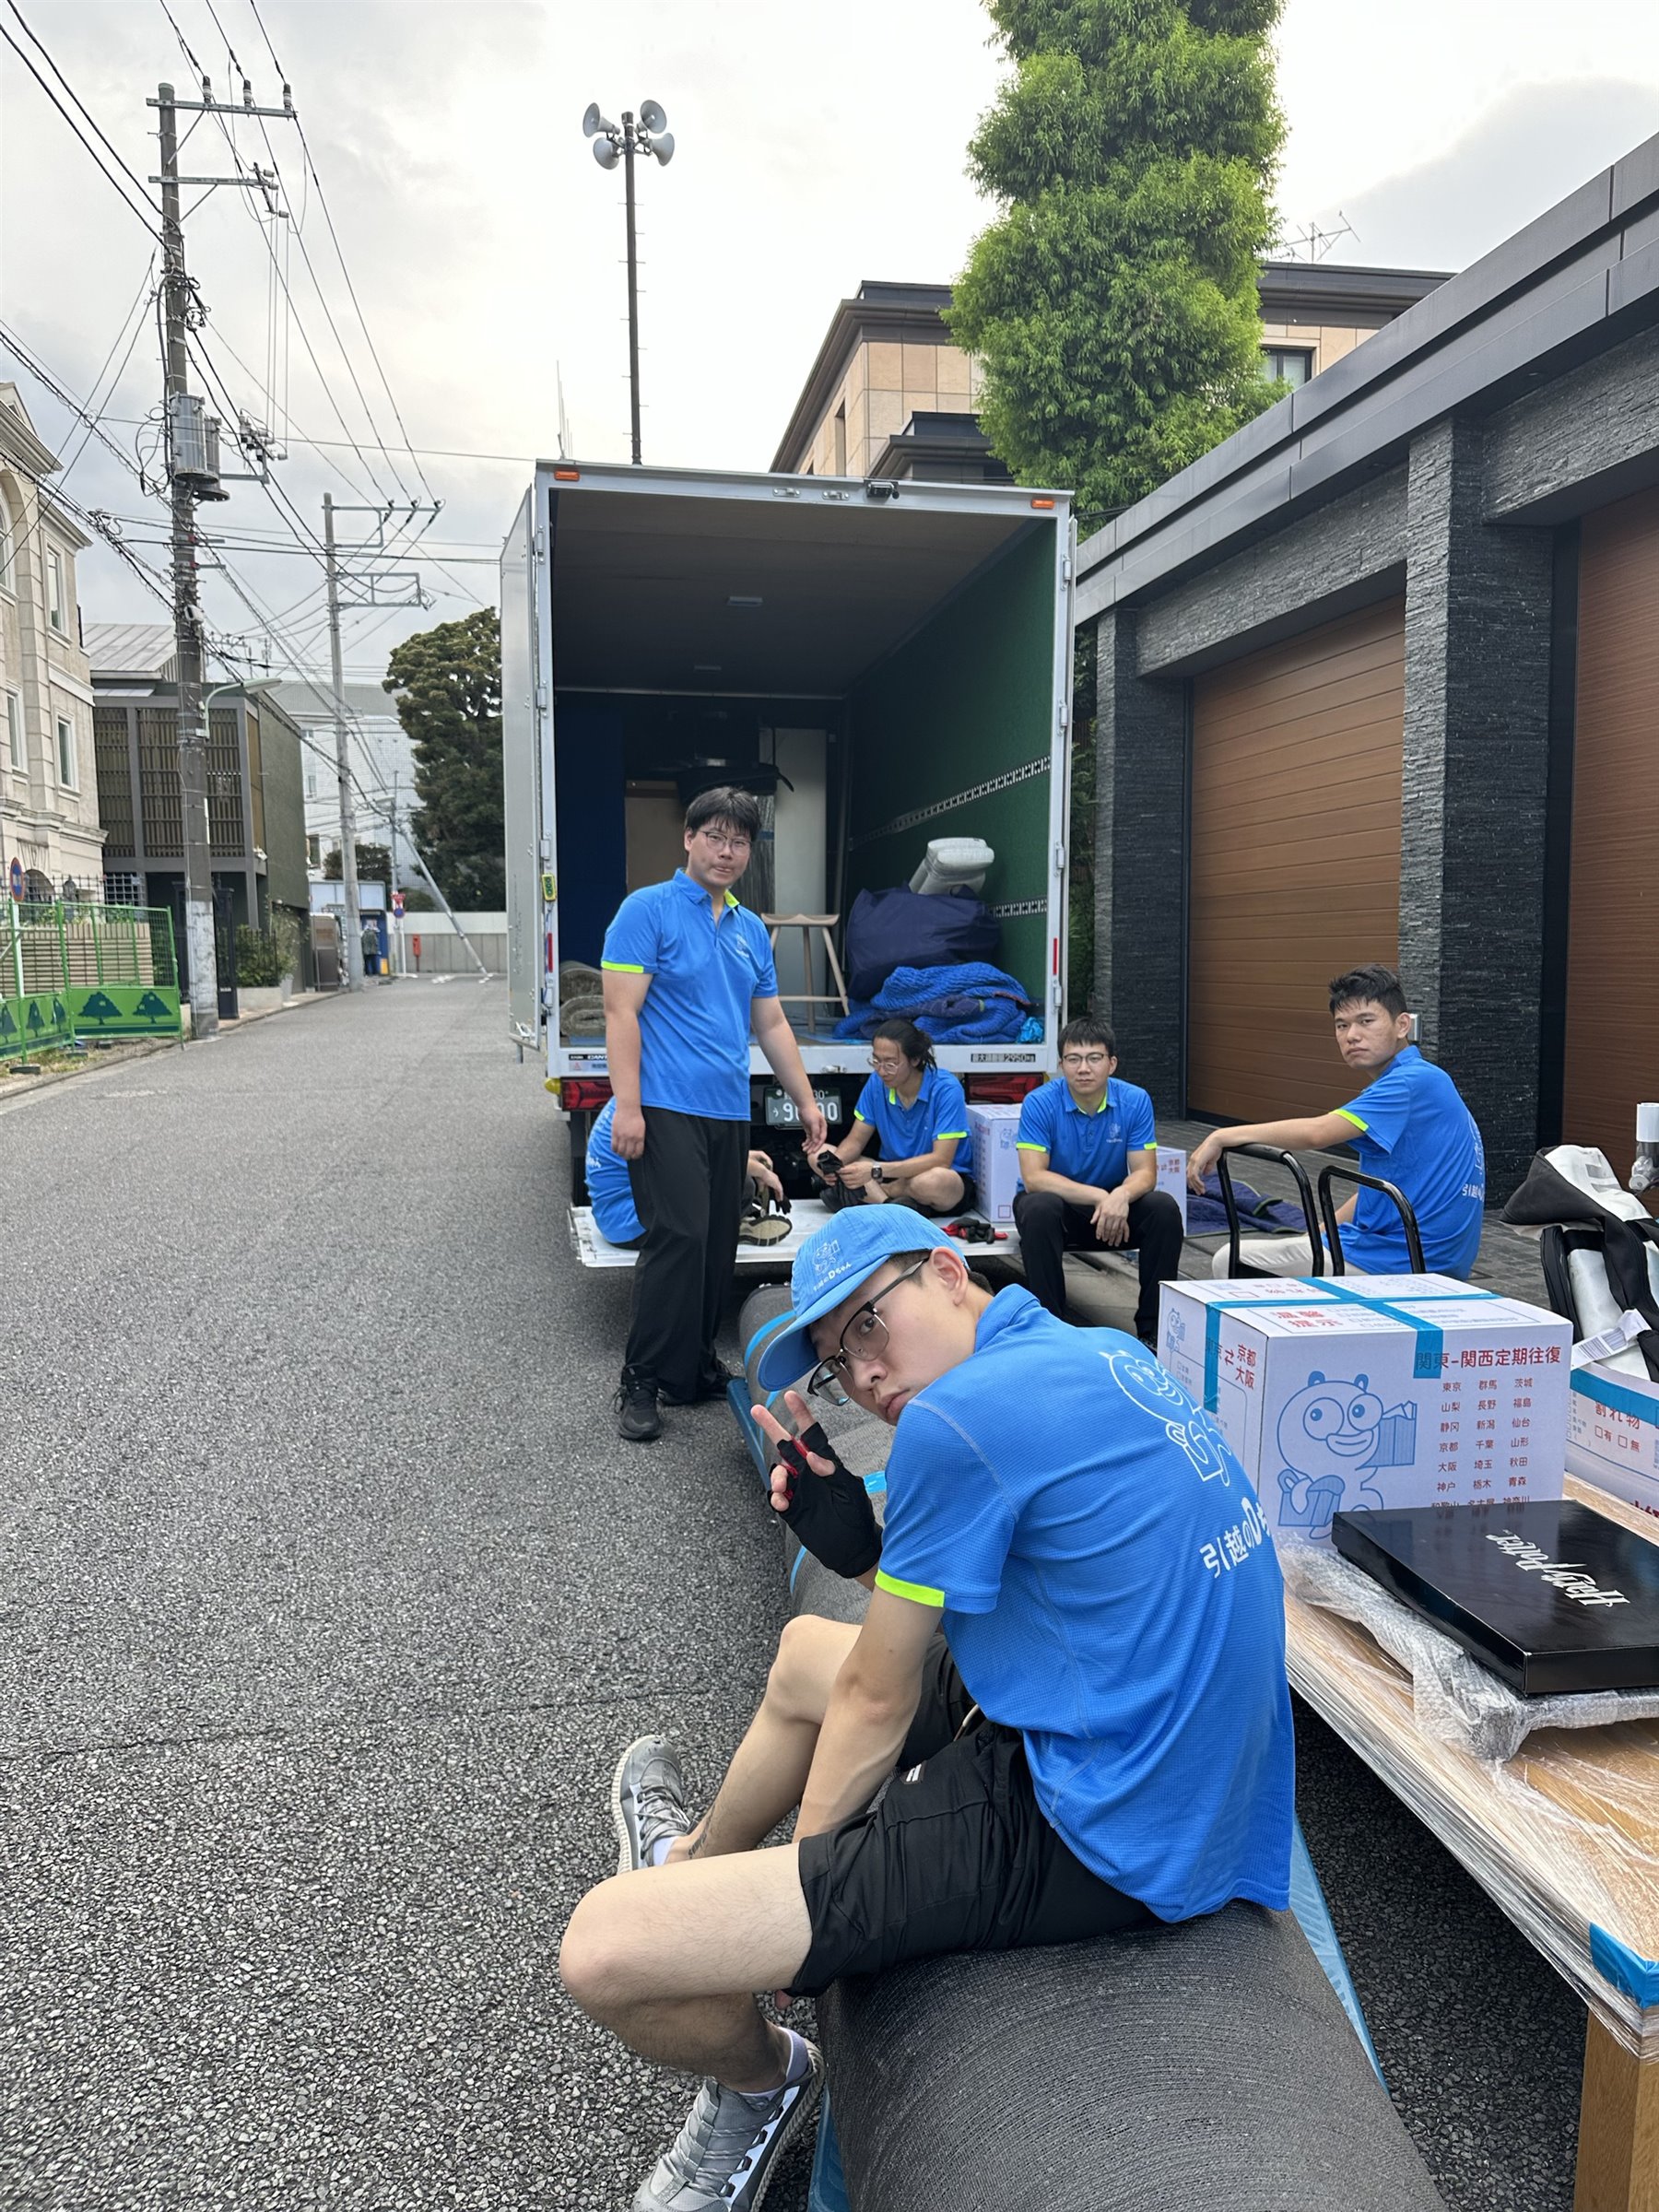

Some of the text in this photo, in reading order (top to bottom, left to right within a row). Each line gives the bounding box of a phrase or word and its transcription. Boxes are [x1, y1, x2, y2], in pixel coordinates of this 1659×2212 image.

[1236, 1343, 1257, 1368] 京都
[1235, 1366, 1255, 1390] 大阪
[1442, 1378, 1534, 1392] 東京 群馬 茨城
[1441, 1397, 1532, 1413] 山梨 長野 福島
[1595, 1400, 1641, 1430] 割れ物
[1512, 1418, 1531, 1429] 仙台
[1439, 1437, 1529, 1453] 京都 千葉 山形
[1438, 1457, 1528, 1473] 大阪 埼玉 秋田
[1509, 1477, 1527, 1487] 青森
[1485, 1534, 1631, 1607] Harry Potter
